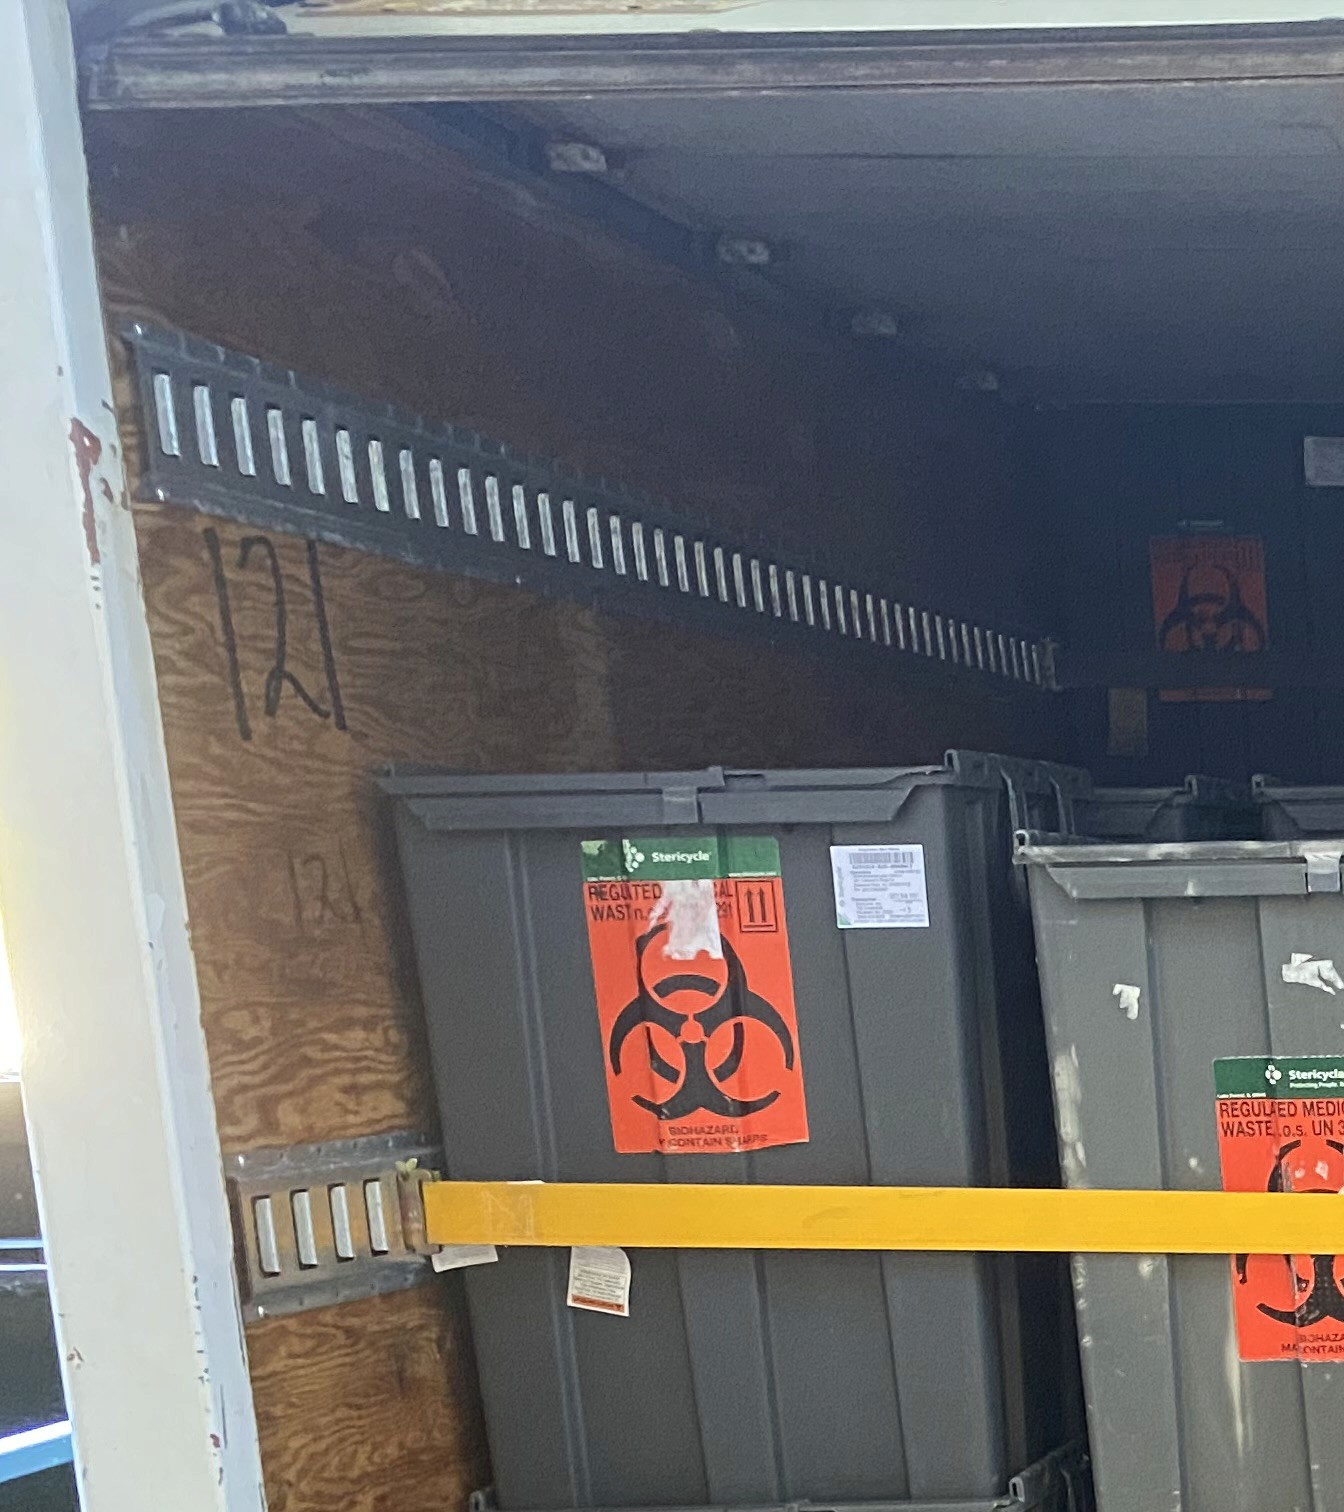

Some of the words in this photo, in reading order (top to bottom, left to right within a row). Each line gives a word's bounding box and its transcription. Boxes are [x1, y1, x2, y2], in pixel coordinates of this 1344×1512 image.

[204, 527, 347, 741] 121
[651, 849, 710, 864] Stericycle
[1312, 1119, 1334, 1137] UN
